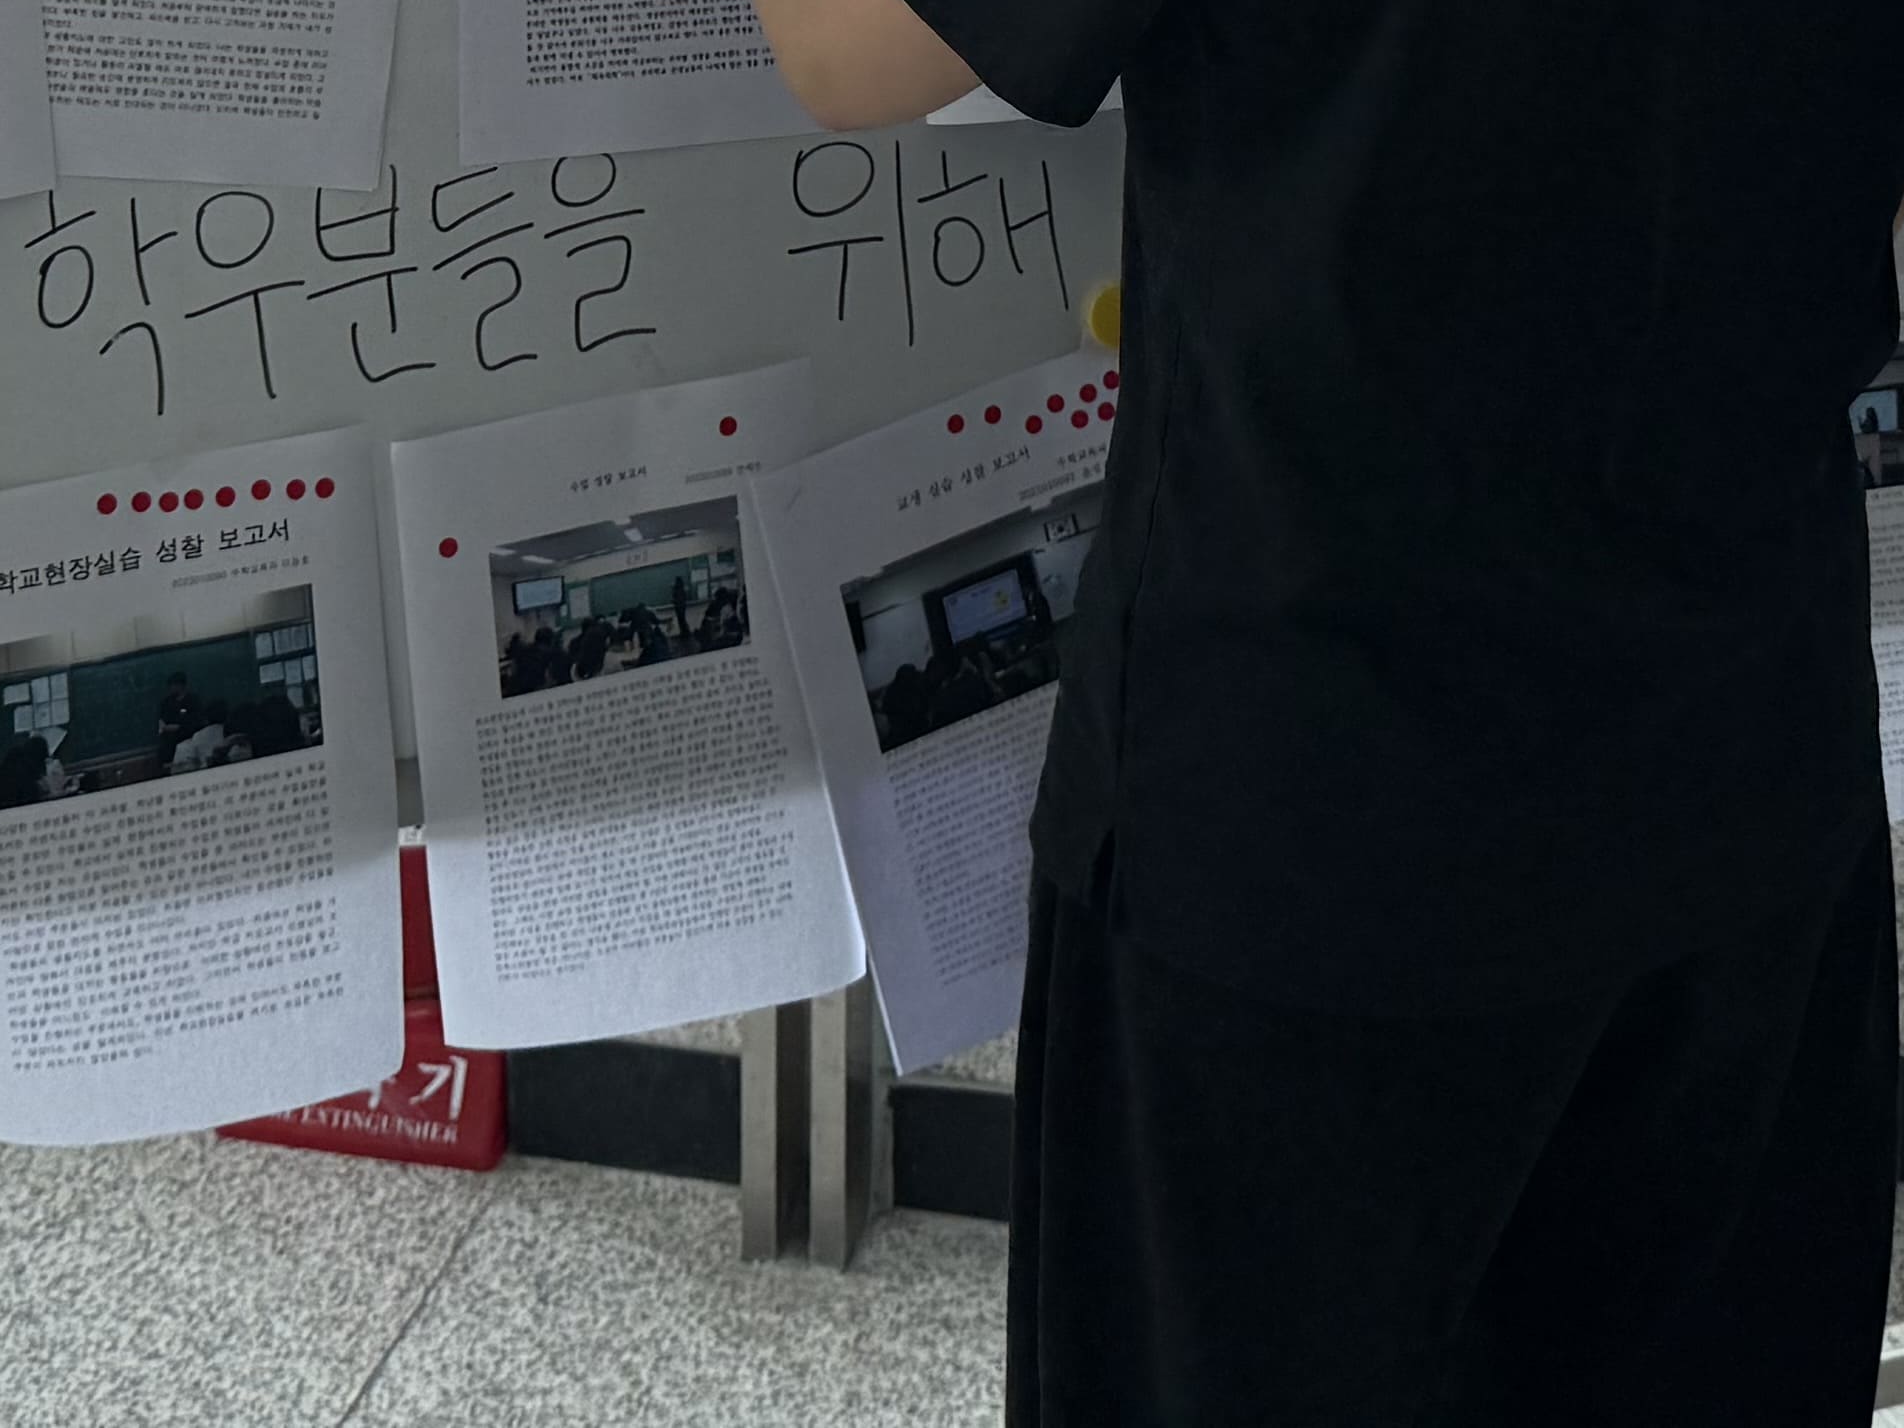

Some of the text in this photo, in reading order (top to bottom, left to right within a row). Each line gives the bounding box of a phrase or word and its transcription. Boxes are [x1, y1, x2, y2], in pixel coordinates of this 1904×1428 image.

[24, 152, 660, 420] 학우분들을
[786, 140, 1069, 349] 위해
[156, 534, 203, 562] 성찰
[219, 519, 288, 549] 보고서
